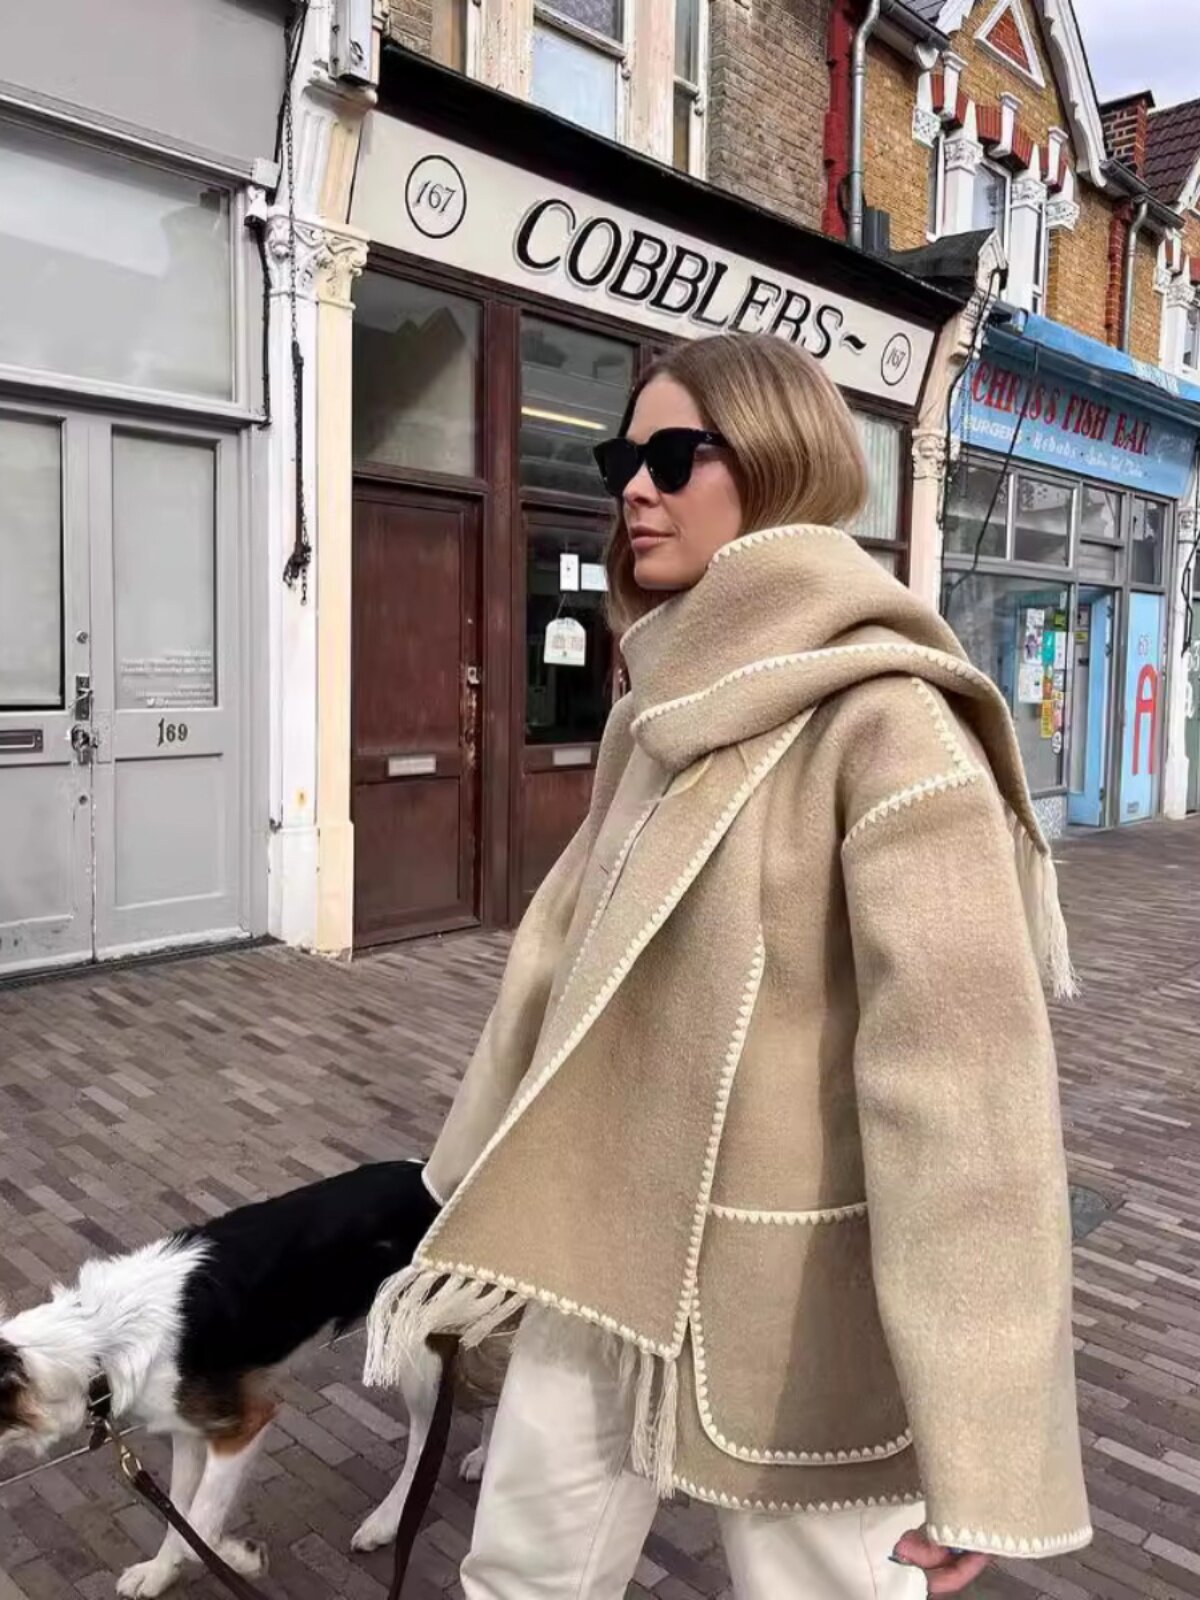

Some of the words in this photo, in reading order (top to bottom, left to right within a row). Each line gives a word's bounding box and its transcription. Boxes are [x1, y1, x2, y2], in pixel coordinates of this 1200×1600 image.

[413, 181, 457, 214] 167
[513, 198, 844, 359] COBBLERS
[1061, 394, 1111, 441] FISH
[158, 717, 188, 747] 169
